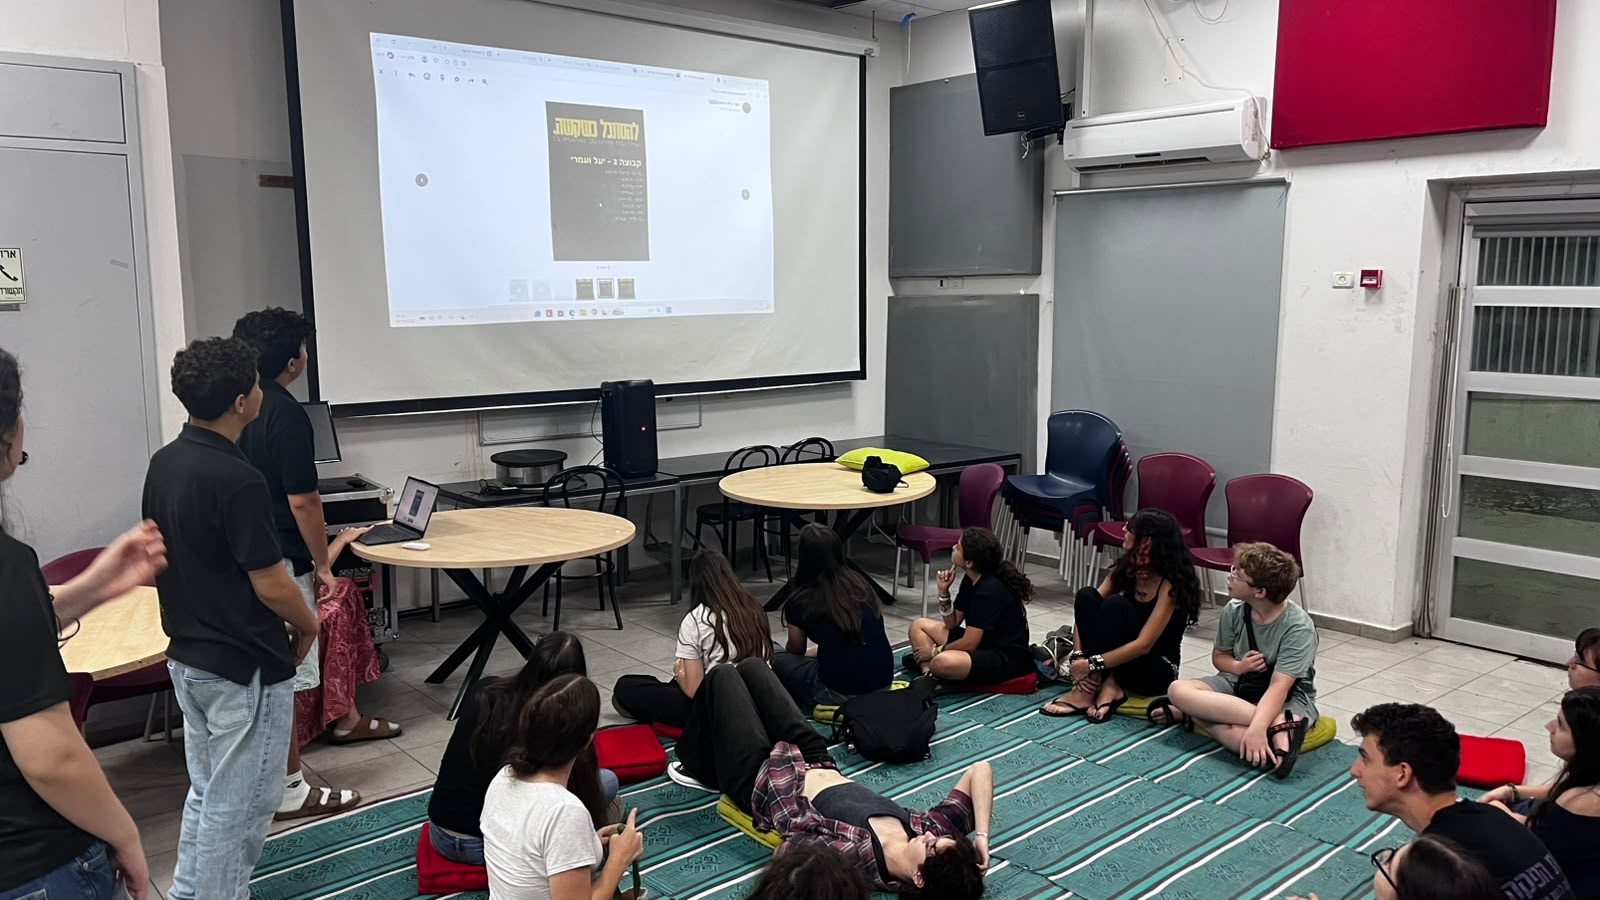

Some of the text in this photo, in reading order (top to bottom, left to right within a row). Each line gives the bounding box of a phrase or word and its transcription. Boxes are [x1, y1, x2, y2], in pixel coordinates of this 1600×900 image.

[570, 156, 591, 164] ועמרי
[593, 156, 606, 164] יעל
[619, 159, 642, 168] קבוצה
[0, 250, 16, 258] ארו
